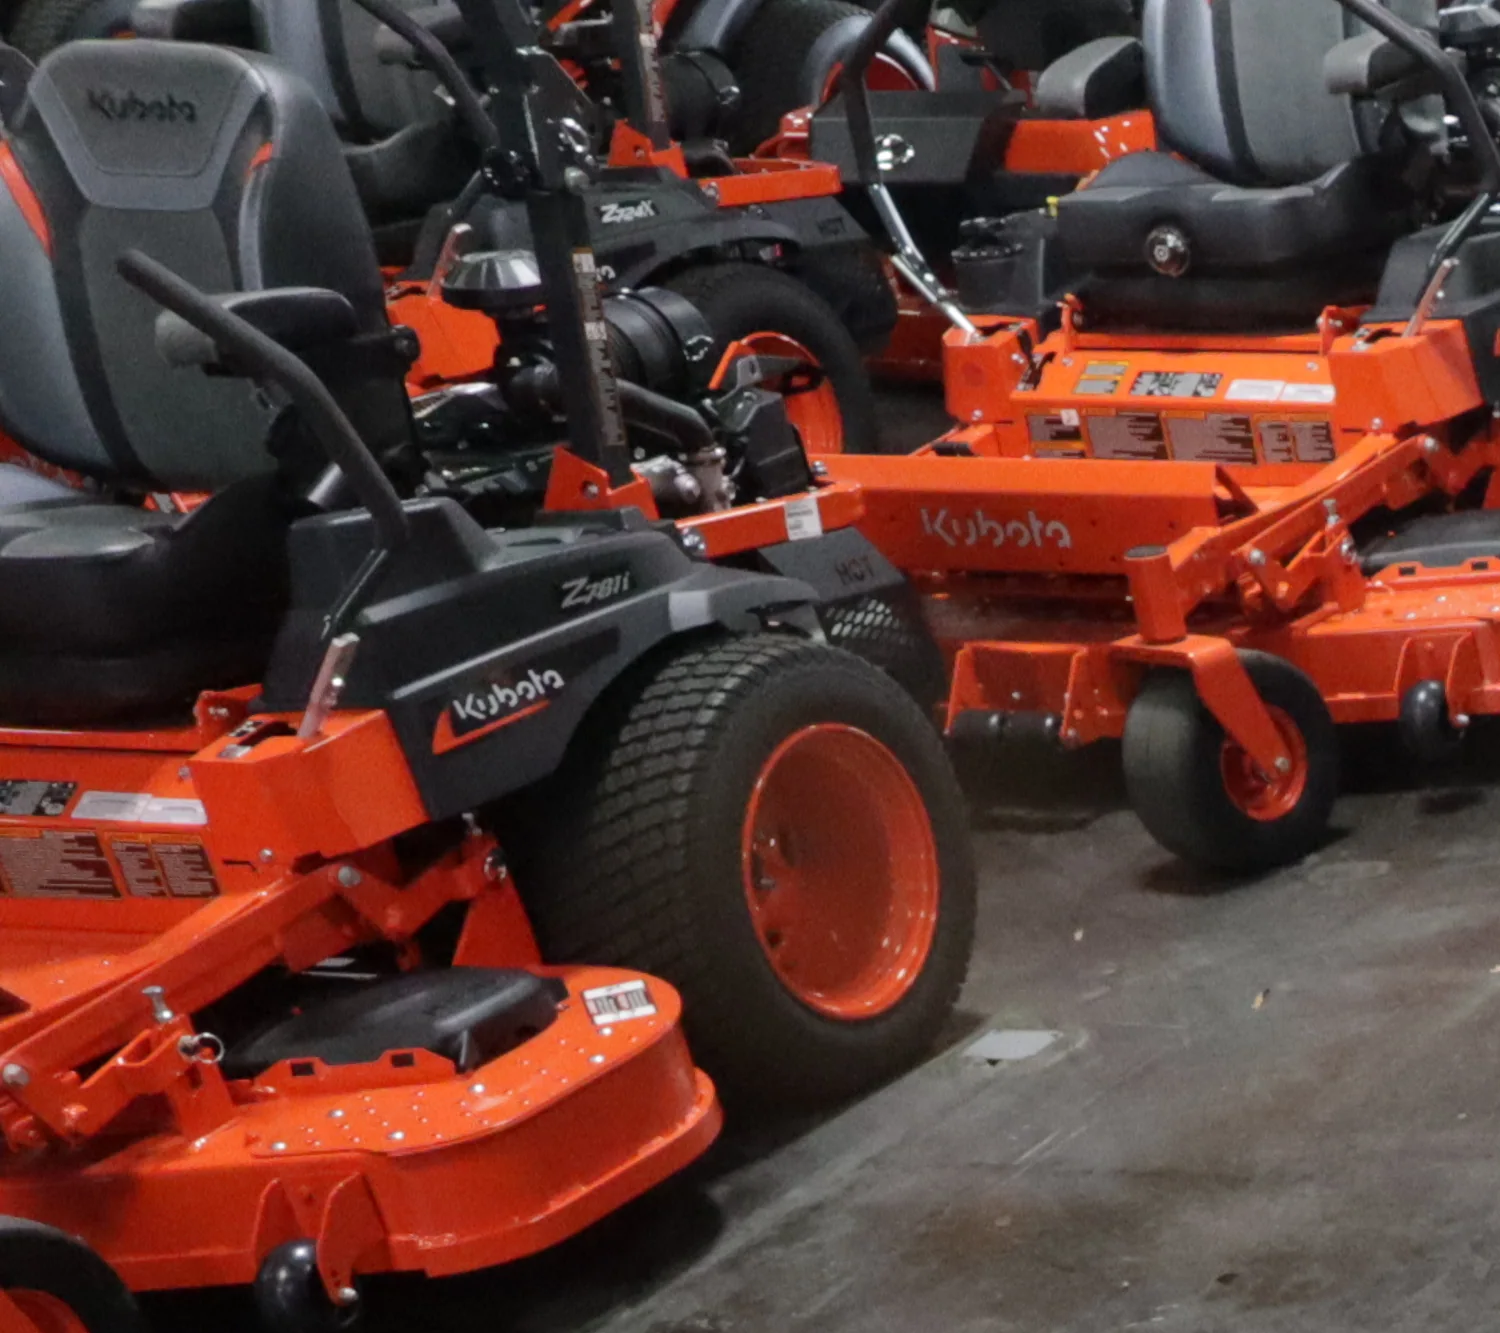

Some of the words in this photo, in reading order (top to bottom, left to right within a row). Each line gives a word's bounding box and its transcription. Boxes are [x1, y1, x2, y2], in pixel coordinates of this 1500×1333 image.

[86, 87, 197, 124] Kubota
[919, 507, 1072, 548] Kubota
[453, 668, 566, 720] Kubota
